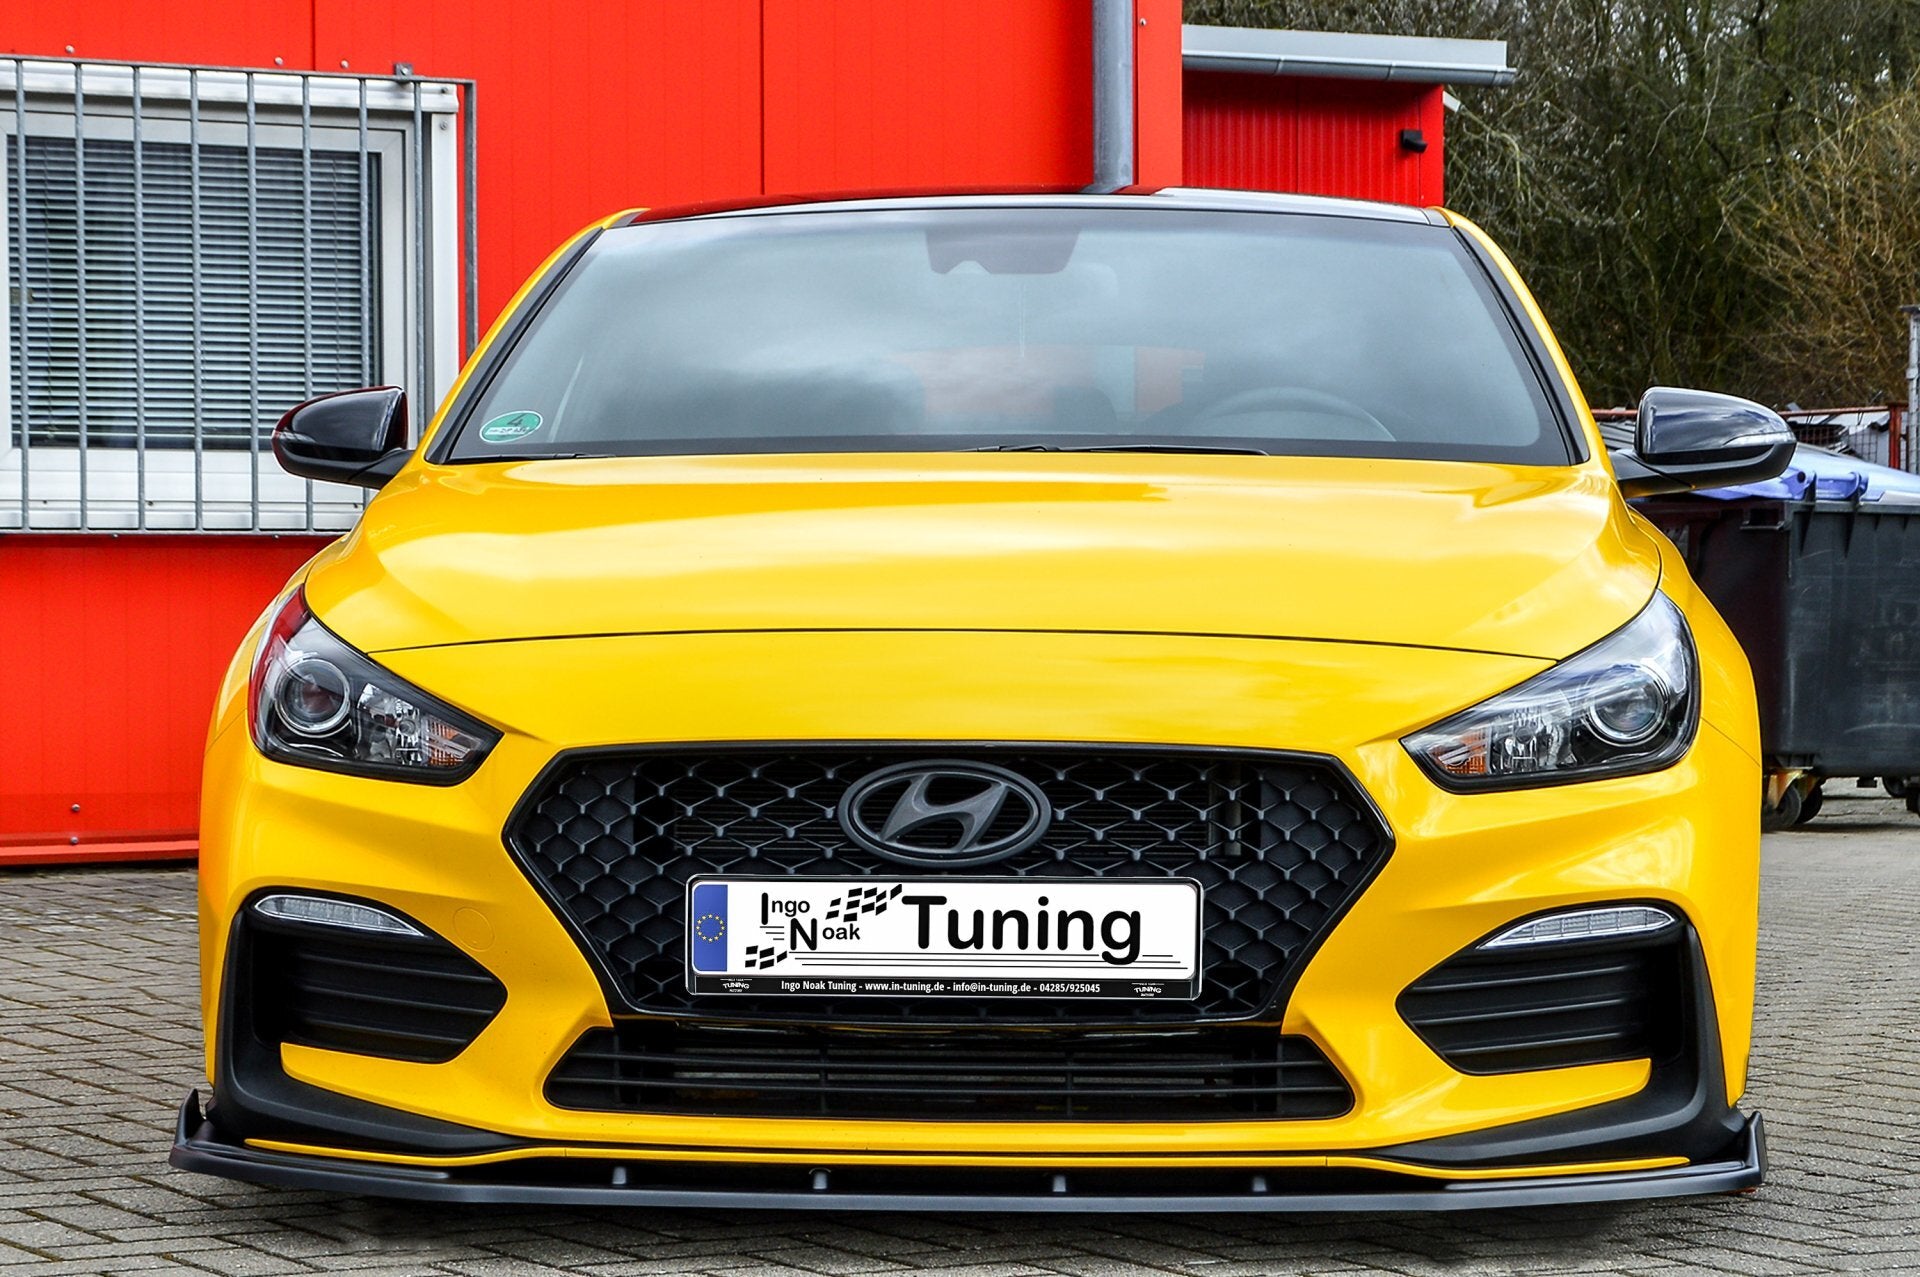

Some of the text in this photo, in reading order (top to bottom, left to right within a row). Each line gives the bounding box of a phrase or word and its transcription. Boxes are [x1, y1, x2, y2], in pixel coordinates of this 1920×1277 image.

[507, 413, 526, 427] 4
[762, 892, 811, 925] Ingo
[790, 917, 861, 951] Noak
[901, 895, 1141, 966] Tuning
[781, 980, 801, 992] Ingo
[802, 980, 826, 990] Noak
[827, 980, 857, 993] Tuning
[864, 981, 945, 994] www.in-tuning.de
[952, 981, 1032, 995] info@in-tuning.de
[1039, 983, 1101, 993] 04285/925045
[1133, 986, 1162, 994] TUNING
